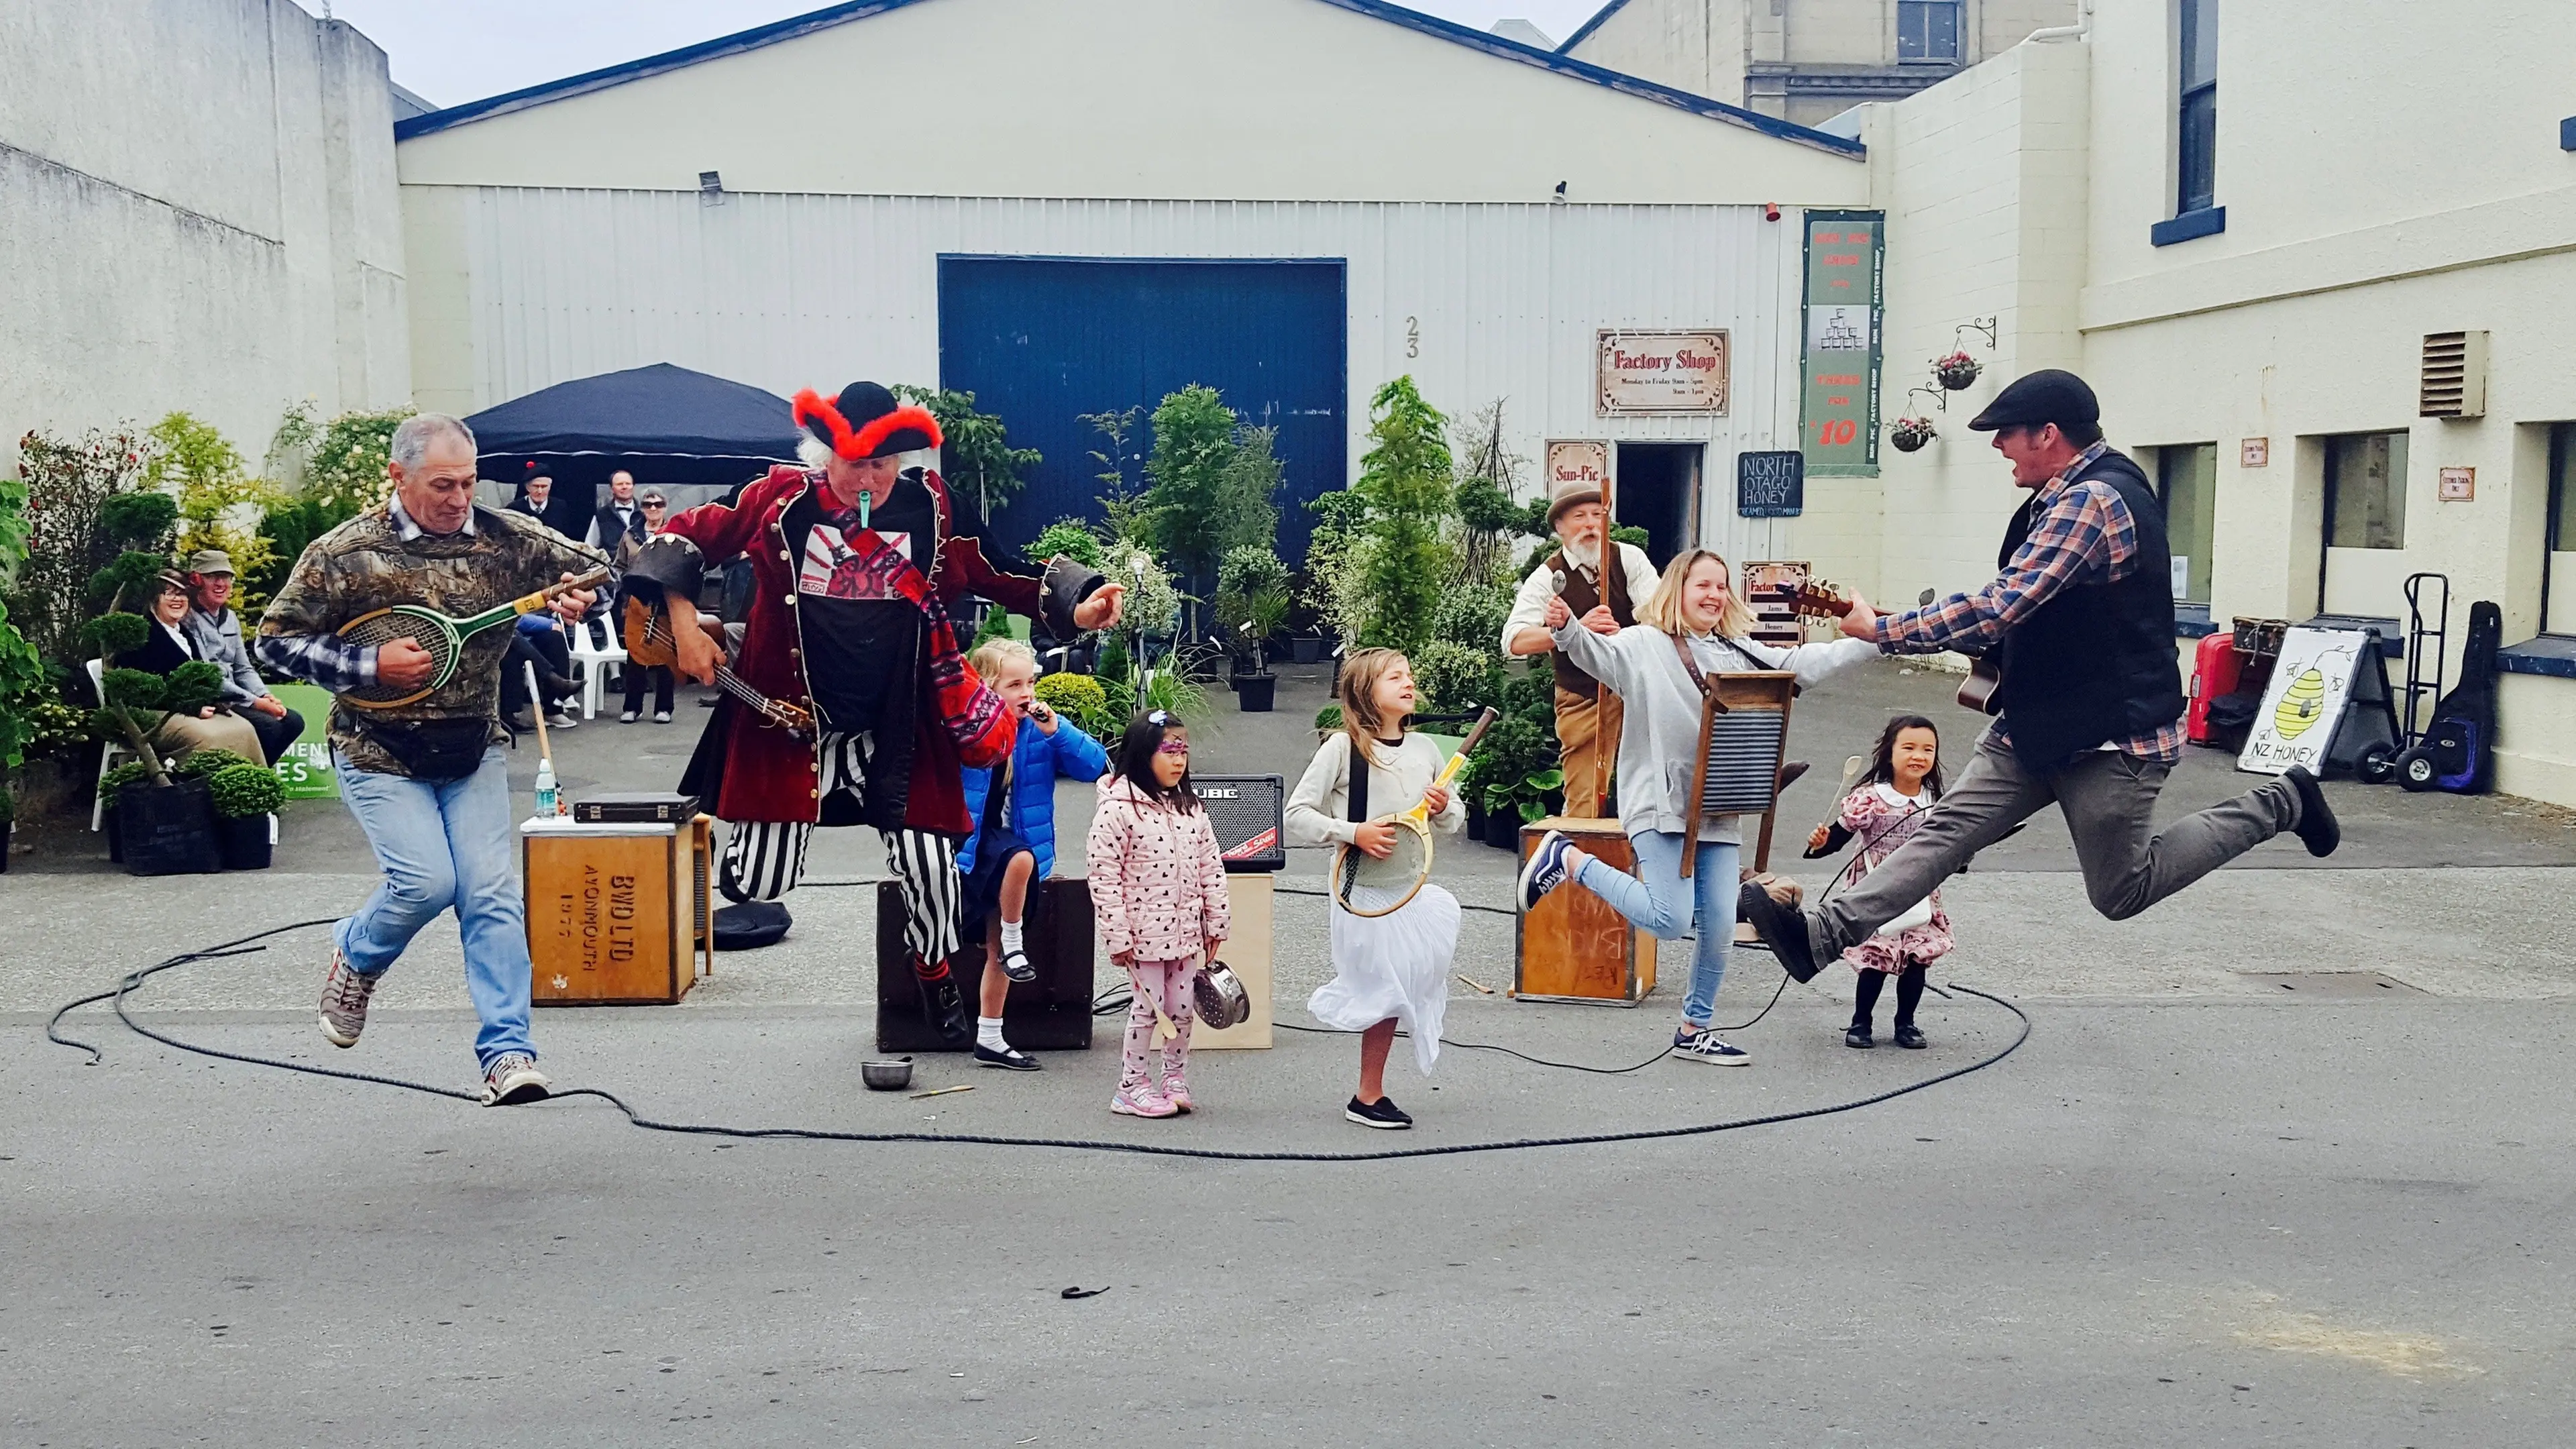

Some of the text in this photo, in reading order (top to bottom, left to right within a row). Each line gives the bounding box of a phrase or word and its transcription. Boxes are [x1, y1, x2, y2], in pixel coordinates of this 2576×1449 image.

[1613, 349, 1717, 372] Factory Shop
[1652, 377, 1670, 385] Friday
[1556, 465, 1599, 482] Sun-Pic
[1744, 455, 1796, 477] NORTH
[1744, 476, 1790, 492] OTAGO
[1744, 489, 1787, 504] HONEY
[1764, 623, 1783, 631] Honey
[2251, 742, 2318, 764] NZ HONEY
[1192, 789, 1238, 798] UBE
[583, 864, 600, 971] AVONMOUTH
[609, 924, 634, 962] LTD
